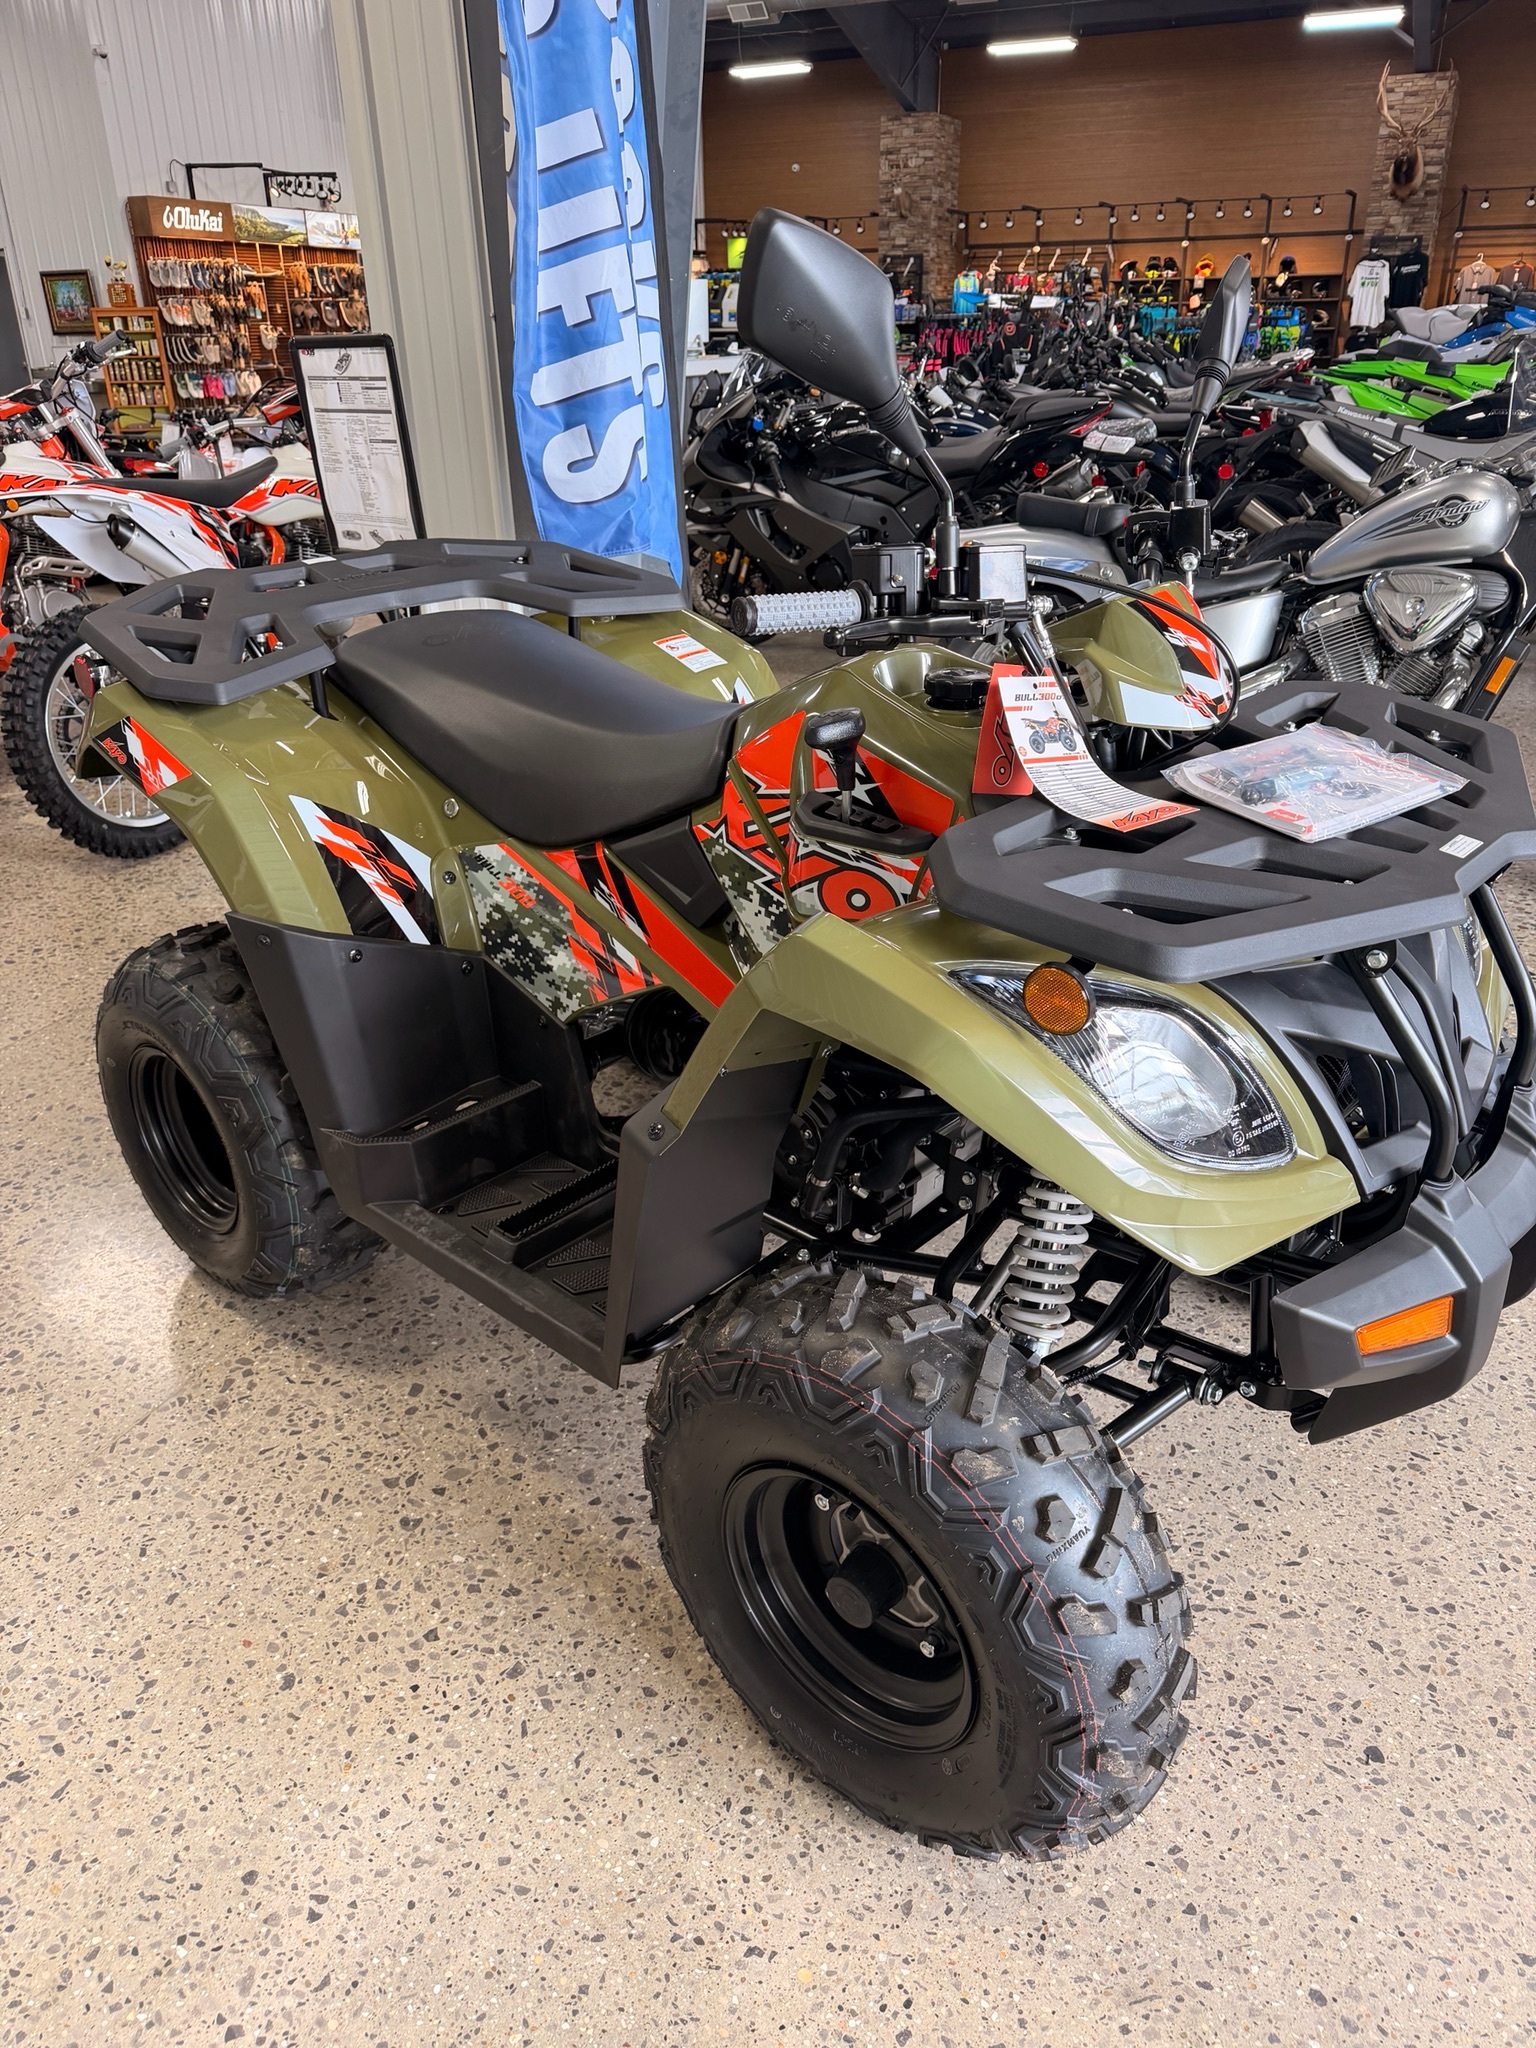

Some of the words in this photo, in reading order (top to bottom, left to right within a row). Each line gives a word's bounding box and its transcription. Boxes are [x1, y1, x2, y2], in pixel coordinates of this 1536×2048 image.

[173, 206, 223, 232] OluKai
[1111, 805, 1179, 828] KAYO
[474, 853, 502, 881] BULL
[497, 876, 537, 909] 300
[1045, 1525, 1092, 1564] YUANXING
